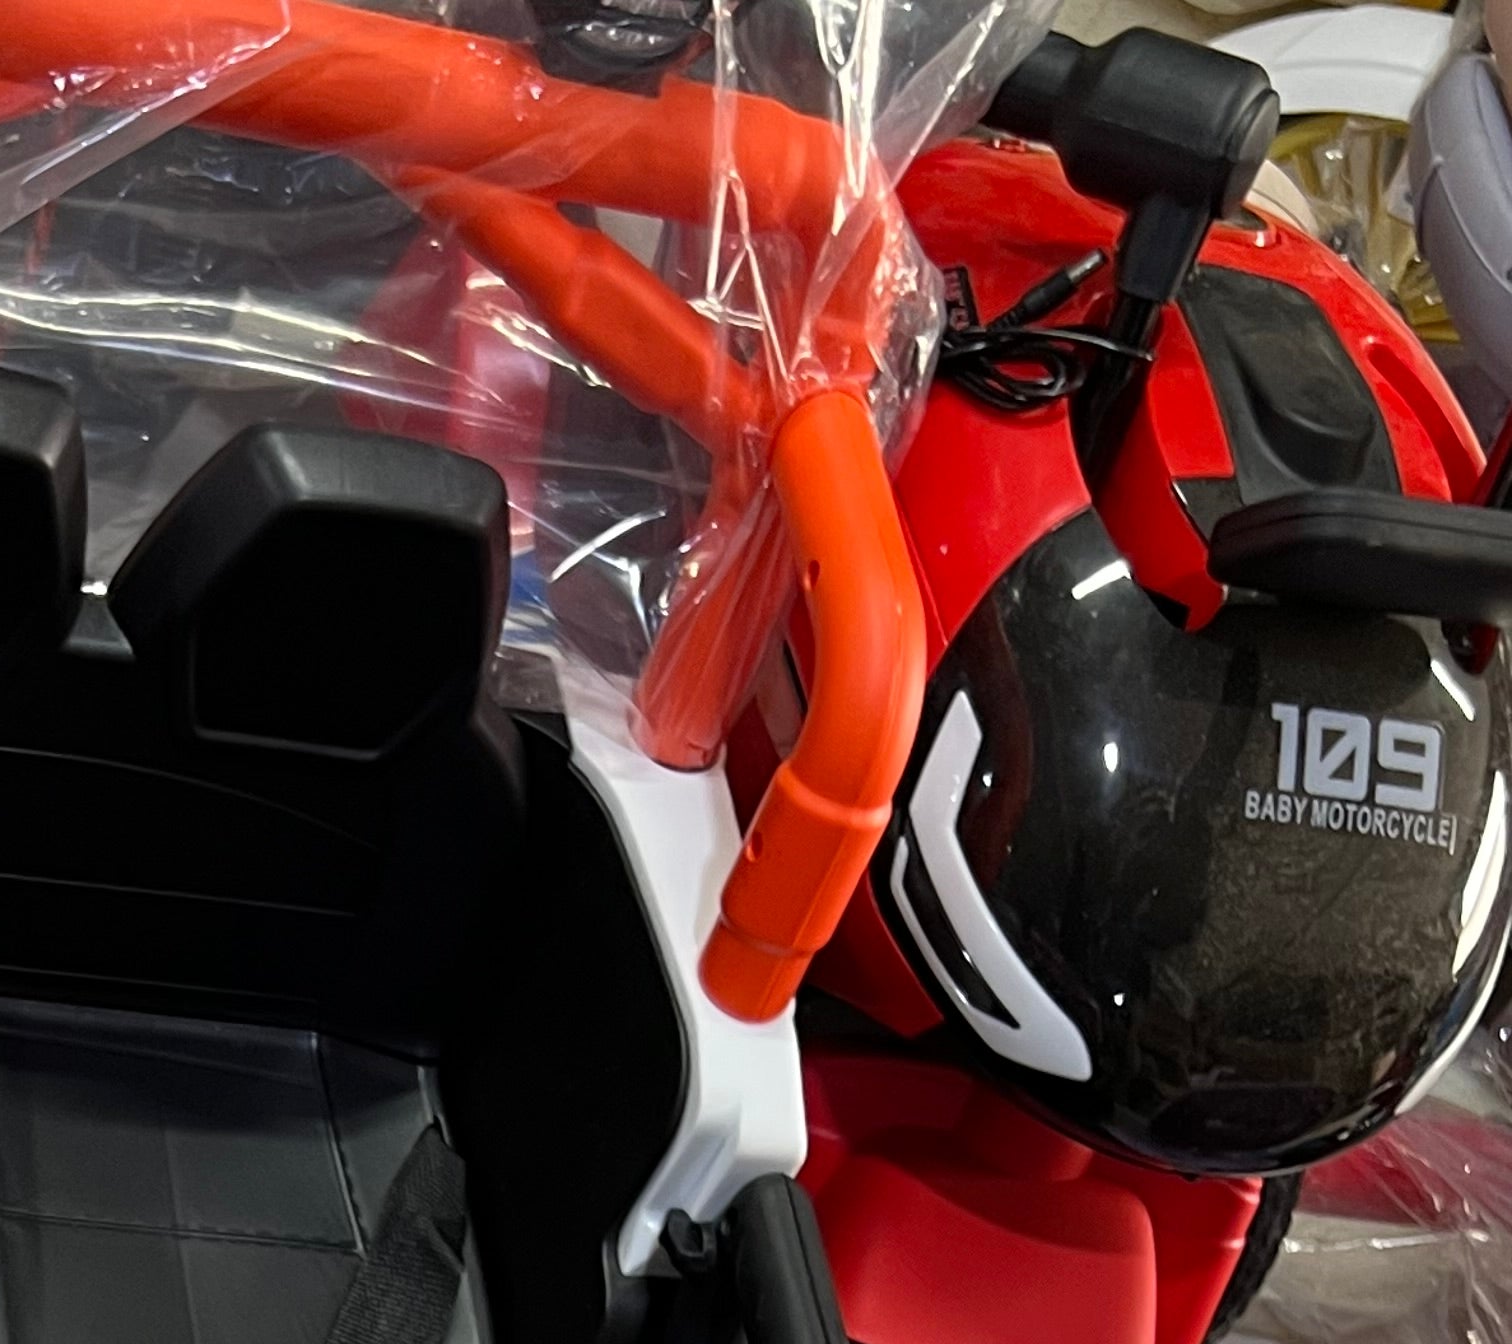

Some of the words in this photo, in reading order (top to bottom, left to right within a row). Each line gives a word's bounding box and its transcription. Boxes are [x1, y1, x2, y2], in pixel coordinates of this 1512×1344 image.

[1271, 702, 1442, 812] 109
[1244, 789, 1308, 825] BABY
[1310, 799, 1451, 848] MOTORCYCLE
